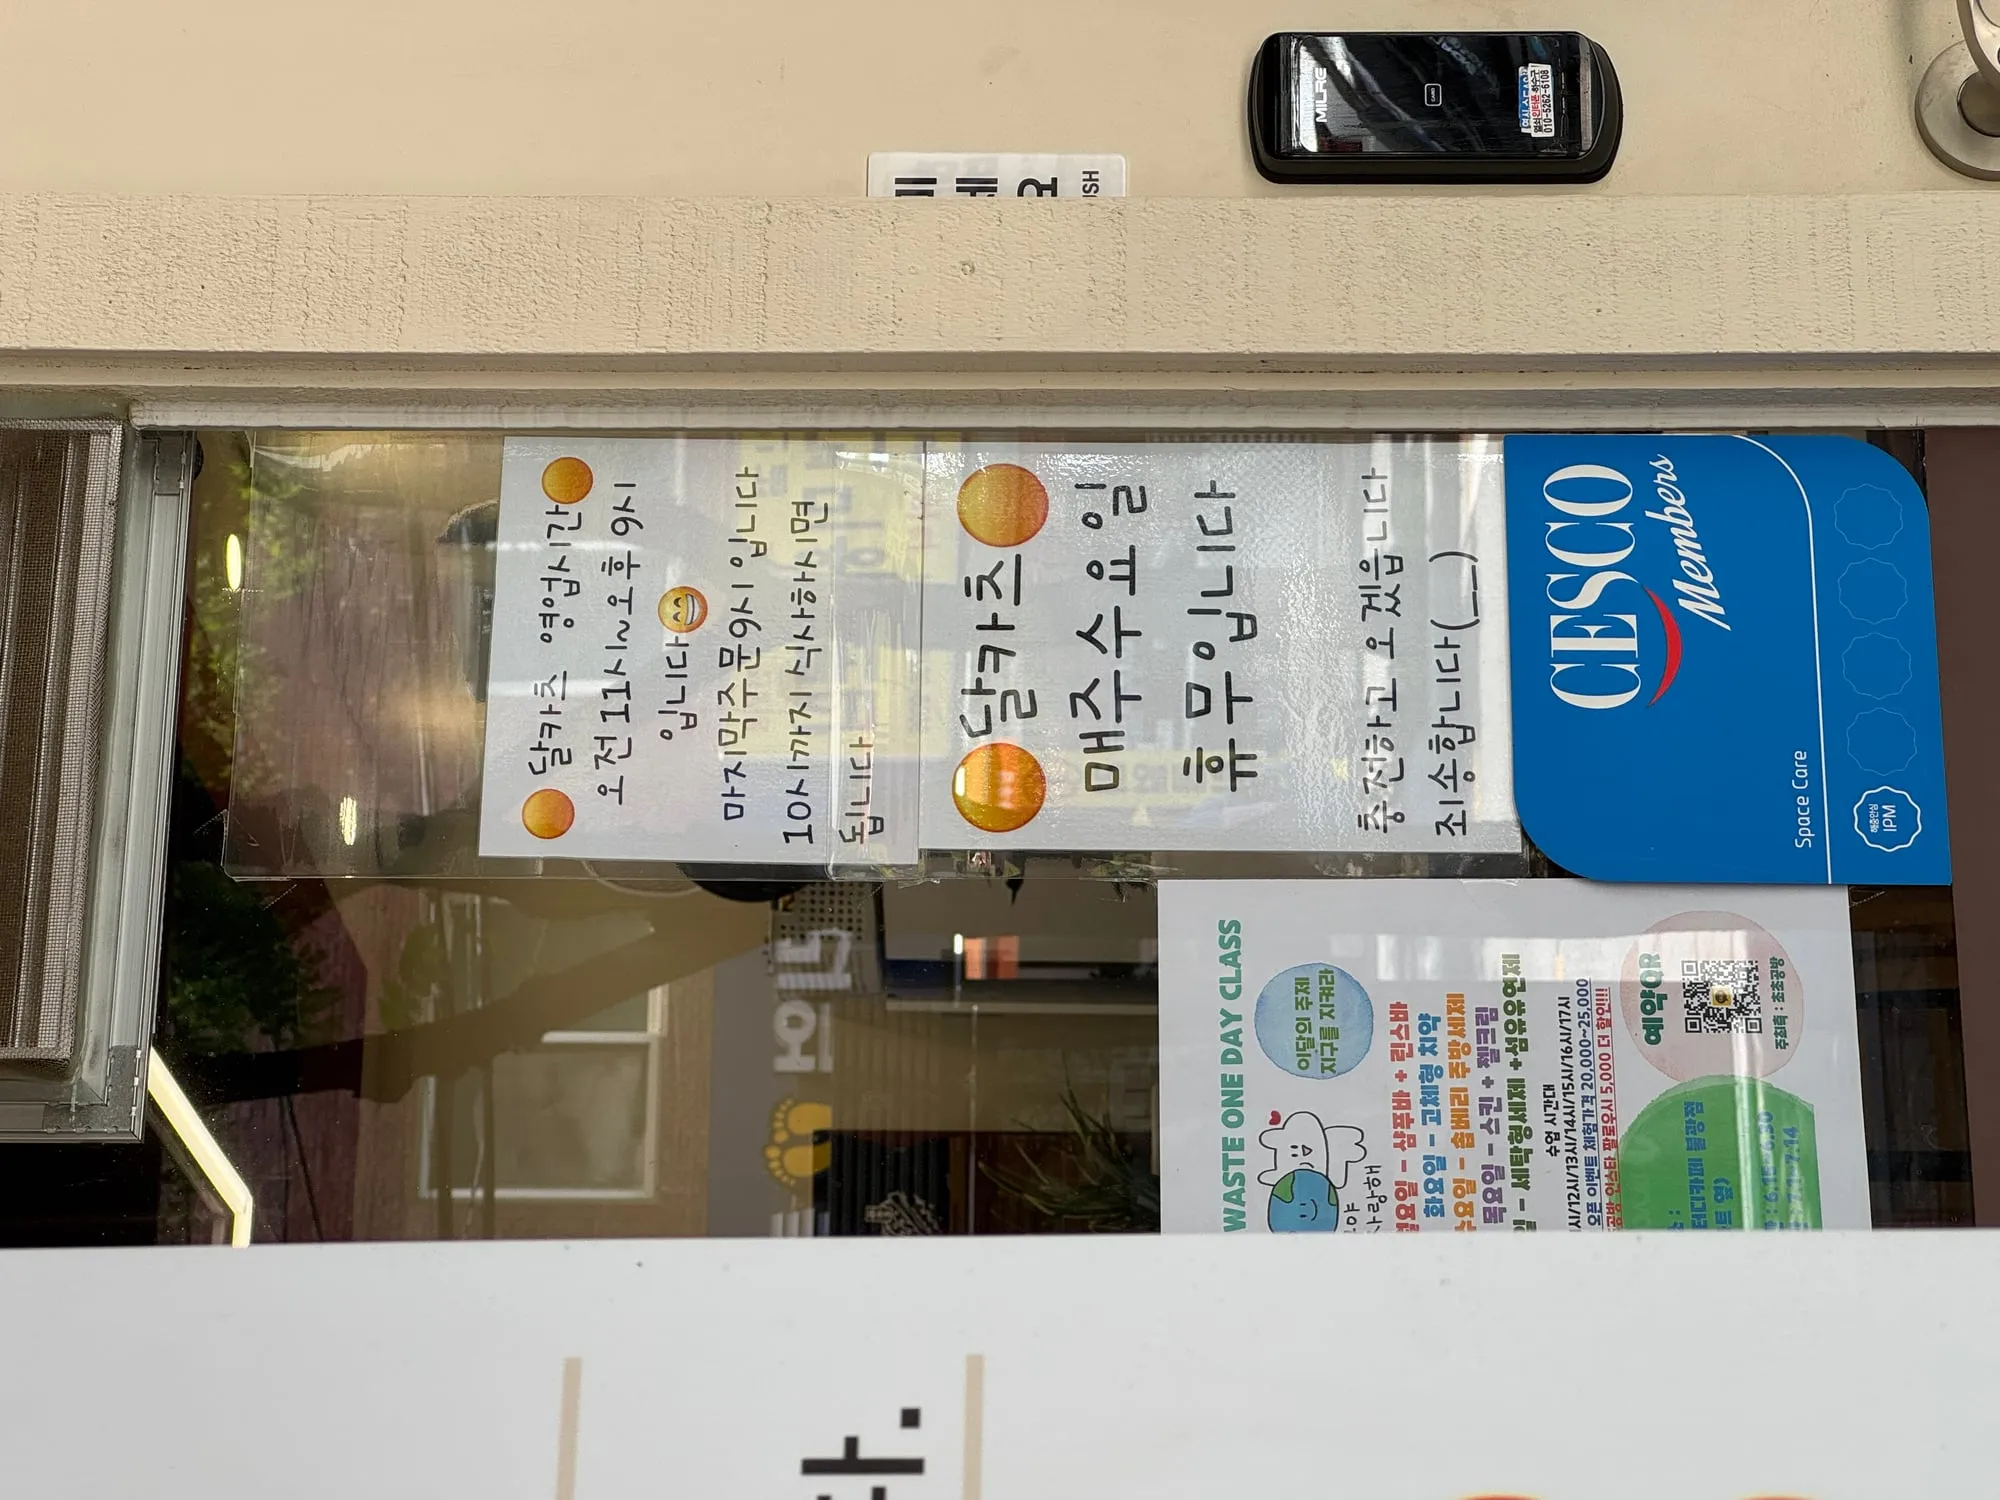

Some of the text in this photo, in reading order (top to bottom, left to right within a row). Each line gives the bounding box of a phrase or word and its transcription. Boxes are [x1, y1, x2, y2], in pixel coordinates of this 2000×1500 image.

[1314, 67, 1328, 123] MILRE
[1540, 69, 1553, 133] 010-5262-6108
[1644, 453, 1731, 631] Members
[1542, 464, 1642, 710] CESCO
[528, 504, 582, 775] 달카츠 영업시간
[718, 466, 768, 821] 마지막주문9시 입니다
[783, 499, 828, 844] 10시까지 식사하시면
[959, 553, 1038, 739] 달카츠
[1068, 482, 1147, 793] 매주수요일
[1182, 479, 1259, 793] 휴무입니다
[1357, 466, 1406, 835] 충전하고 오겠읍니다
[658, 636, 697, 740] 입니다
[593, 736, 632, 805] 오전
[838, 736, 884, 845] 됩니다
[1791, 750, 1815, 848] Space Care
[1881, 804, 1898, 832] IPM
[1595, 987, 1611, 1030] 할인!!!
[1639, 953, 1668, 1045] 예약QR
[1770, 956, 1786, 1003] 초초공방
[1293, 977, 1316, 1070] 이달의 주제
[1317, 969, 1339, 1074] 지구를 지켜라
[1390, 1001, 1413, 1063] 린스바
[1418, 1012, 1441, 1057] 치약
[1446, 992, 1472, 1080] 주방세제
[1475, 1006, 1499, 1069] 젤크림
[1597, 1034, 1612, 1048] 더
[1218, 919, 1246, 1233] WASTE ONE DAY CLASS
[1419, 1063, 1442, 1126] 고체형
[1576, 978, 1602, 1227] 오픈 이벤트 체험가격 20,000~25,000
[1599, 1052, 1614, 1094] 5,000
[1391, 1089, 1415, 1152] 샴푸바
[1478, 1096, 1502, 1135] 스킨
[1507, 1077, 1534, 1191] 세탁형세제
[1543, 1084, 1561, 1157] 수업 시간대
[1600, 1099, 1618, 1151] 팔로우시
[1684, 1101, 1706, 1151] 불광점
[1421, 1154, 1446, 1218] 화요일
[1481, 1163, 1506, 1224] 목요일
[1603, 1156, 1620, 1196] 인스타
